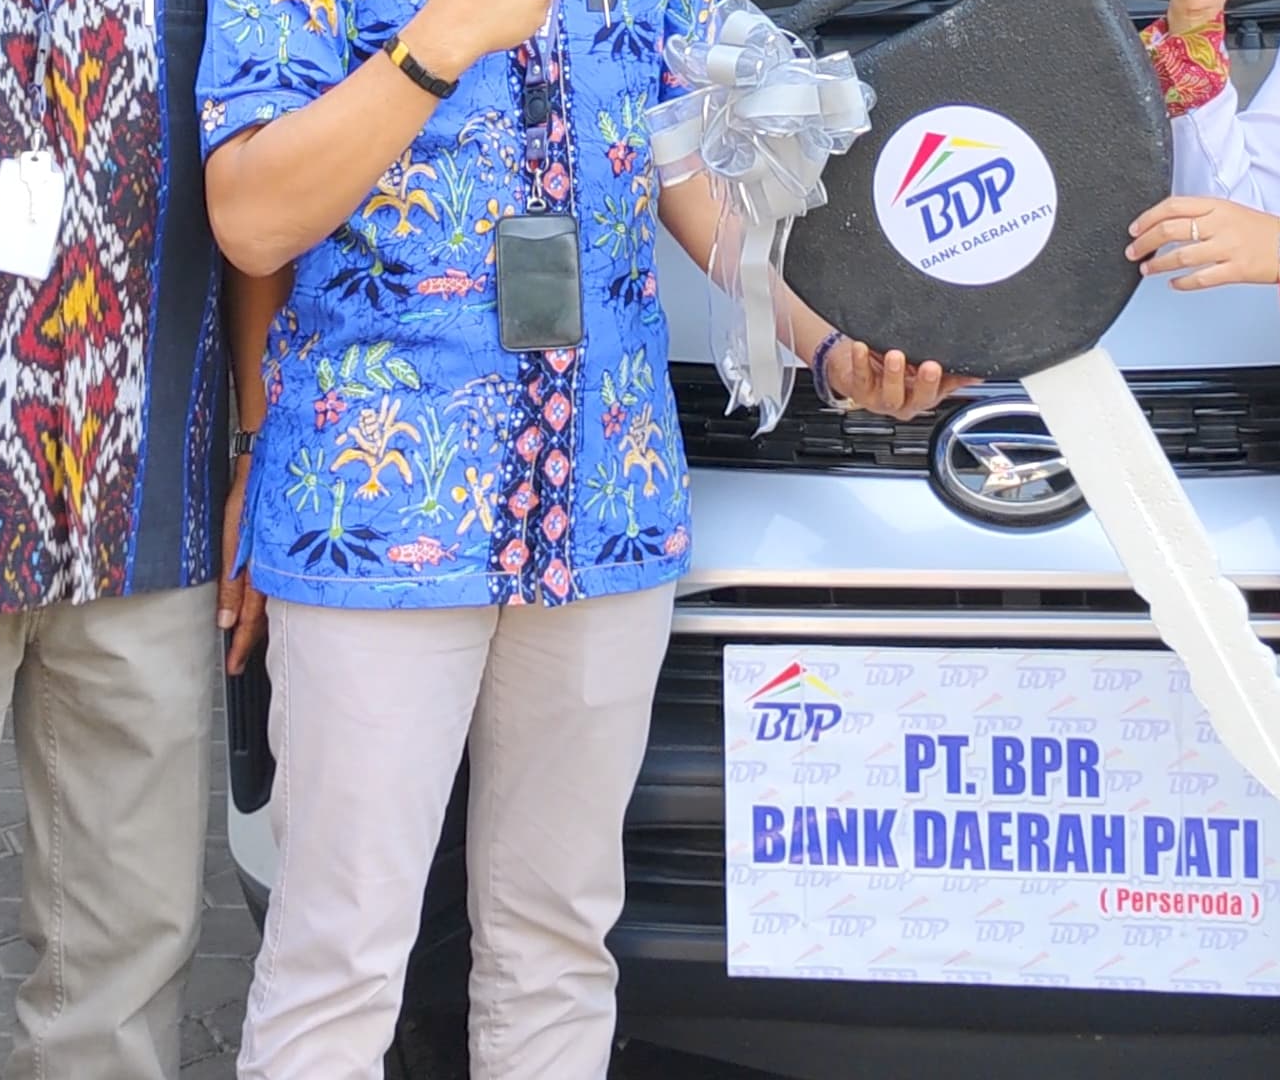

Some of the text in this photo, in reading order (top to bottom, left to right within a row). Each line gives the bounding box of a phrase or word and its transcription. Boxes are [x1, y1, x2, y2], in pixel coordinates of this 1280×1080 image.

[905, 157, 1016, 243] BDP
[920, 203, 1053, 270] BANK DAERAH PATI
[752, 702, 843, 742] BDP
[904, 734, 1100, 798] PT. BPR
[752, 805, 1259, 879] BANK DAERAH PATI
